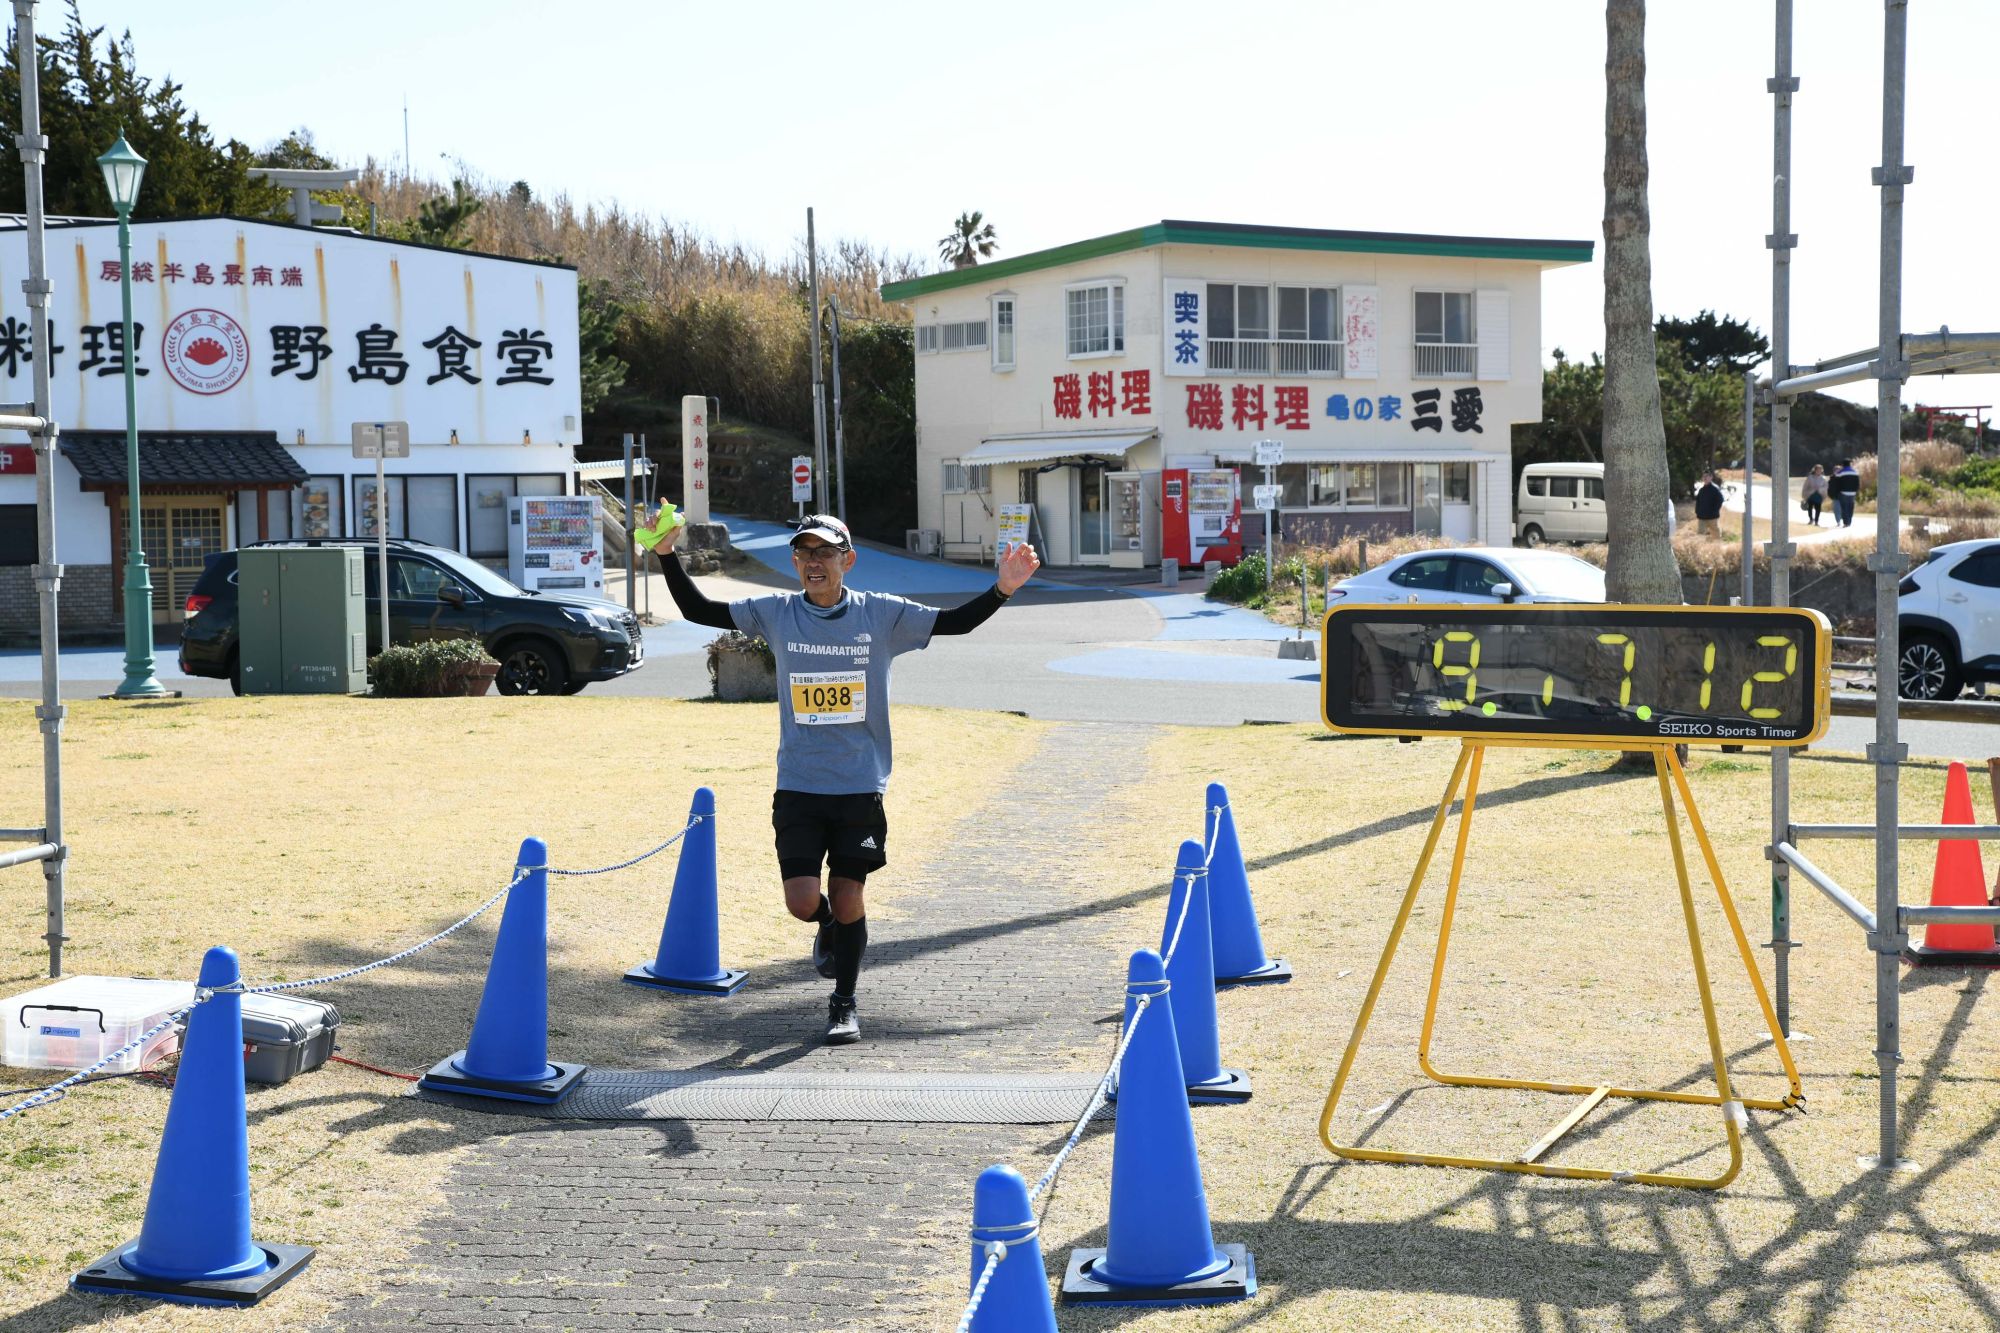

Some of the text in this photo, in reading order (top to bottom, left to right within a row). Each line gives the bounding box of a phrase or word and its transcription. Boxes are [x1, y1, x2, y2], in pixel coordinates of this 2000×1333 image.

[100, 261, 304, 288] 房総半島最南端
[1174, 291, 1200, 365] 喫茶
[269, 323, 555, 386] 野島食堂
[175, 366, 239, 389] NOJIMA SHOKUDO
[1053, 369, 1152, 419] 磯料理
[1186, 383, 1484, 434] 磯料理 亀の家 三愛
[787, 641, 870, 656] ULTRAMARATHON
[853, 657, 870, 665] 2025
[802, 687, 851, 707] 1038
[1658, 722, 1797, 738] SEIKO Sports Timer
